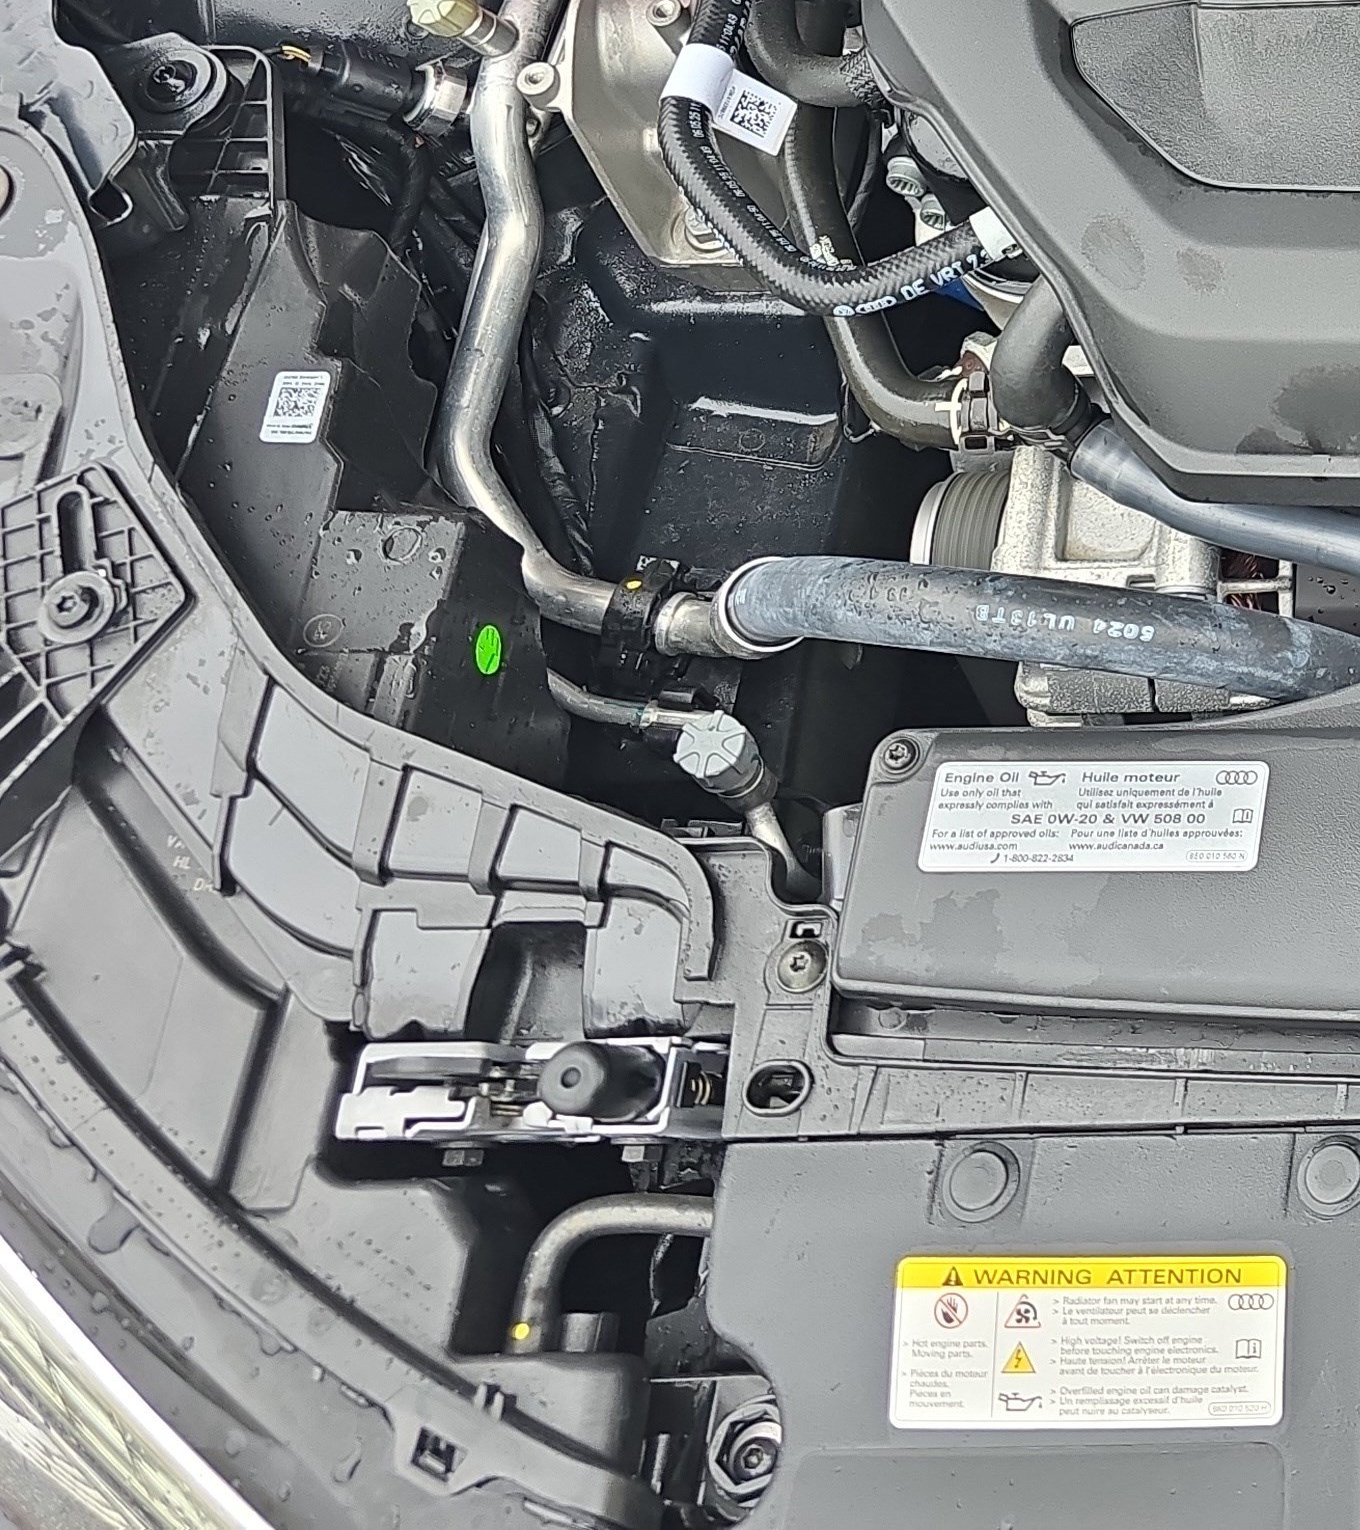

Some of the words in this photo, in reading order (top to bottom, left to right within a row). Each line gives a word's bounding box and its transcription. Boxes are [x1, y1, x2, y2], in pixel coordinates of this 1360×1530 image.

[901, 277, 927, 302] DE
[930, 257, 966, 288] VRT
[944, 772, 995, 785] Engine
[999, 772, 1020, 784] Oil
[1082, 772, 1119, 783] Huile
[1123, 772, 1181, 783] moteur
[940, 789, 960, 798] Use
[962, 789, 984, 799] only
[986, 789, 1000, 797] oil
[1001, 789, 1022, 797] that
[1078, 788, 1114, 797] Utilisez
[1116, 788, 1176, 799] uniquement
[1177, 788, 1190, 797] de
[938, 801, 985, 811] expressly
[985, 801, 1030, 811] complies
[1032, 800, 1053, 810] with
[1076, 800, 1093, 811] qui
[1095, 800, 1134, 809] satisfait
[1136, 799, 1206, 811] expressément
[1010, 814, 1044, 825] SAE
[1047, 814, 1098, 824] 0W-20
[1102, 814, 1115, 824] &
[1121, 814, 1150, 824] VW
[1153, 814, 1182, 824] 508
[1186, 814, 1206, 824] 00
[932, 828, 949, 838] For
[950, 830, 957, 838] a
[959, 828, 974, 838] list
[976, 828, 988, 838] of
[989, 829, 1036, 840] approved
[1038, 829, 1060, 838] oils:
[1070, 829, 1095, 838] Pour
[1118, 828, 1139, 838] liste
[1182, 828, 1243, 840] approuvées:
[929, 841, 1018, 851] www.audiusa.com
[1068, 841, 1164, 851] www.audicanada.ca
[1003, 854, 1074, 863] 1-800-822-2834
[973, 1269, 1092, 1285] WARNING
[1106, 1268, 1242, 1284] ATTENTION
[1062, 1296, 1102, 1306] Radiator
[1103, 1296, 1118, 1305] fan
[1119, 1298, 1140, 1307] may
[1142, 1296, 1163, 1305] start
[1165, 1296, 1174, 1305] at
[1175, 1297, 1193, 1306] any
[1194, 1296, 1218, 1305] time.
[1062, 1306, 1073, 1315] Le
[1075, 1306, 1124, 1315] ventilateur
[1126, 1307, 1147, 1317] peut
[1069, 1316, 1089, 1325] tout
[1090, 1317, 1131, 1325] moment.
[911, 1338, 929, 1348] Hot
[930, 1339, 961, 1350] engine
[962, 1340, 989, 1349] parts.
[1061, 1336, 1082, 1347] High
[1084, 1336, 1121, 1347] voltage!
[1123, 1336, 1155, 1345] Switch
[1156, 1336, 1170, 1345] off
[1171, 1336, 1203, 1346] engine
[911, 1349, 946, 1360] Moving
[947, 1350, 974, 1359] parts.
[1060, 1346, 1090, 1356] before
[1091, 1346, 1133, 1357] touching
[1133, 1346, 1166, 1357] engine
[1166, 1345, 1219, 1355] electronics.
[1060, 1356, 1087, 1365] Haute
[1161, 1356, 1171, 1364] le
[1173, 1356, 1207, 1365] moteur
[940, 1369, 953, 1378] du
[955, 1369, 988, 1378] moteur
[1059, 1367, 1085, 1376] avant
[1086, 1366, 1099, 1375] de
[1100, 1366, 1136, 1375] toucher
[1209, 1365, 1222, 1374] du
[940, 1390, 952, 1398] en
[1059, 1386, 1105, 1396] Overfilled
[1105, 1387, 1138, 1398] engine
[1139, 1386, 1152, 1395] oil
[1153, 1387, 1170, 1395] can
[1171, 1386, 1210, 1397] damage
[1059, 1396, 1073, 1406] Un
[1075, 1396, 1131, 1407] remplissage
[1059, 1407, 1079, 1417] peut
[1081, 1406, 1105, 1416] nuire
